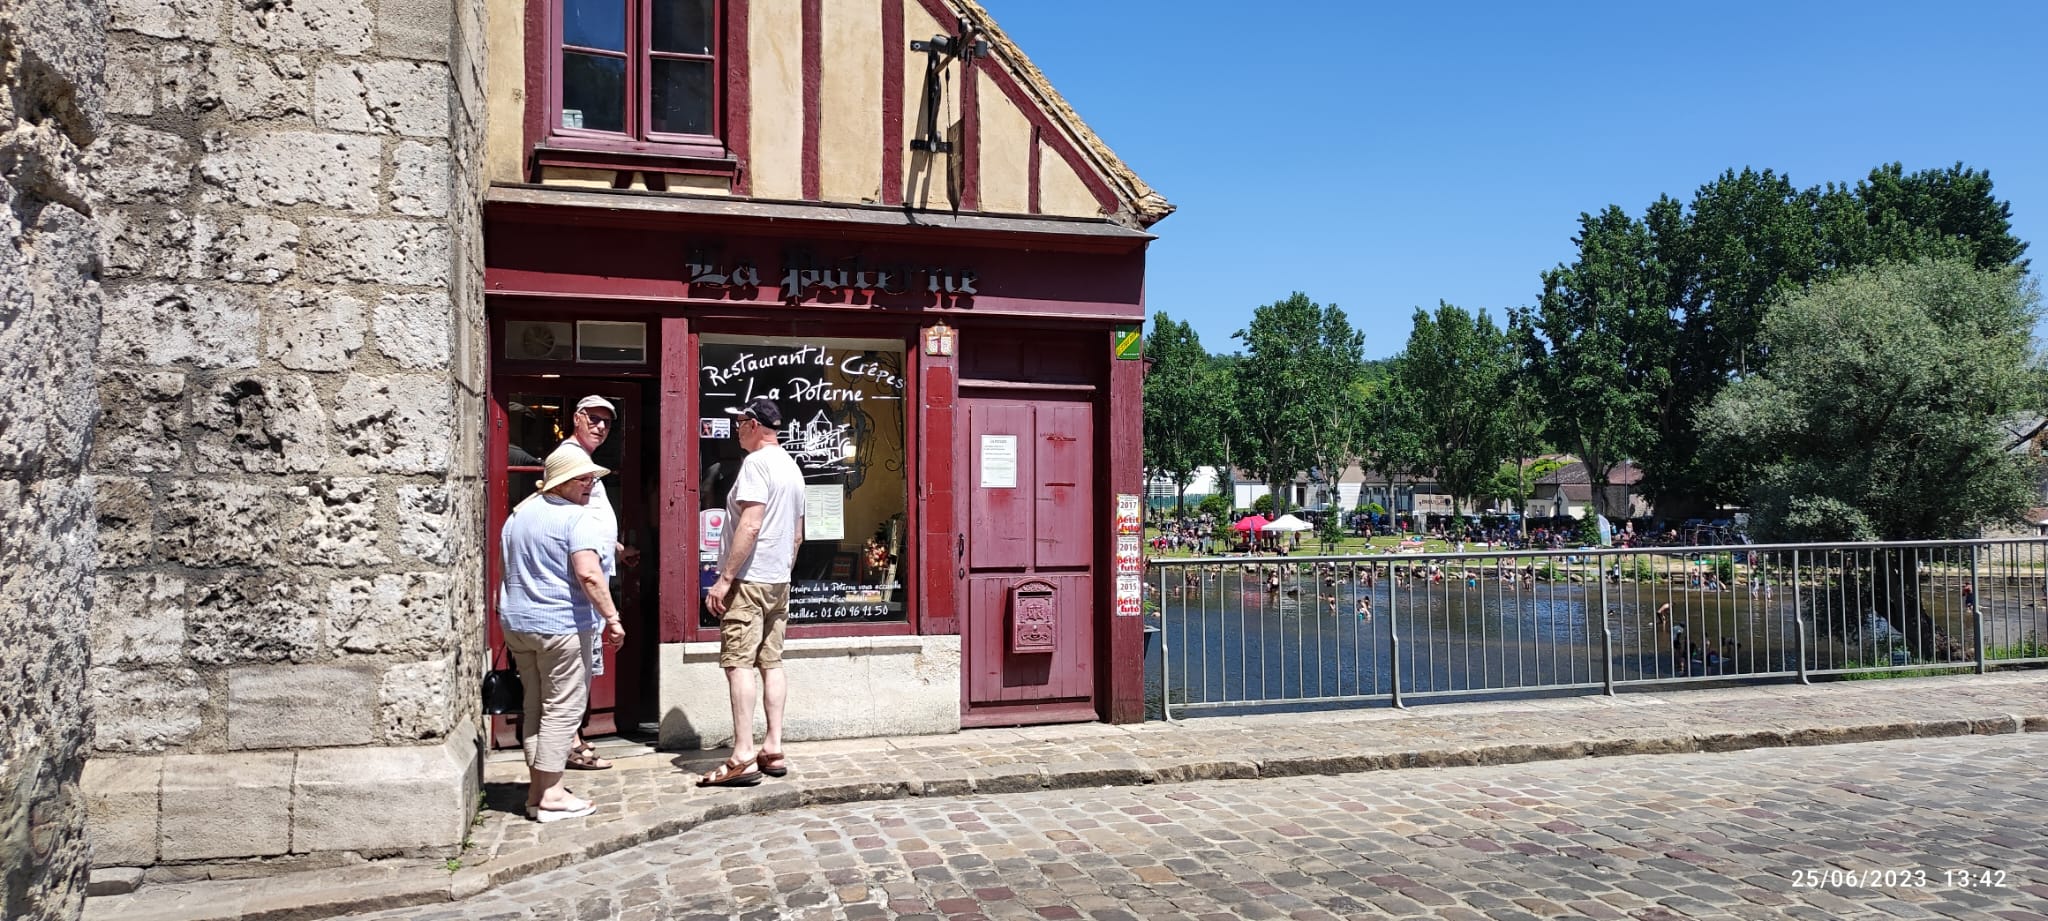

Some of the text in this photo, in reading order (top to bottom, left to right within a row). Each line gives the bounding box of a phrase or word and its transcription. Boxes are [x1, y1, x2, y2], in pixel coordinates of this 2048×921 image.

[684, 243, 762, 286] La
[702, 344, 904, 389] Restaurant de Crêpes
[744, 377, 864, 403] La Poterne
[820, 606, 832, 618] 01
[834, 605, 847, 617] 60
[874, 604, 889, 616] 50
